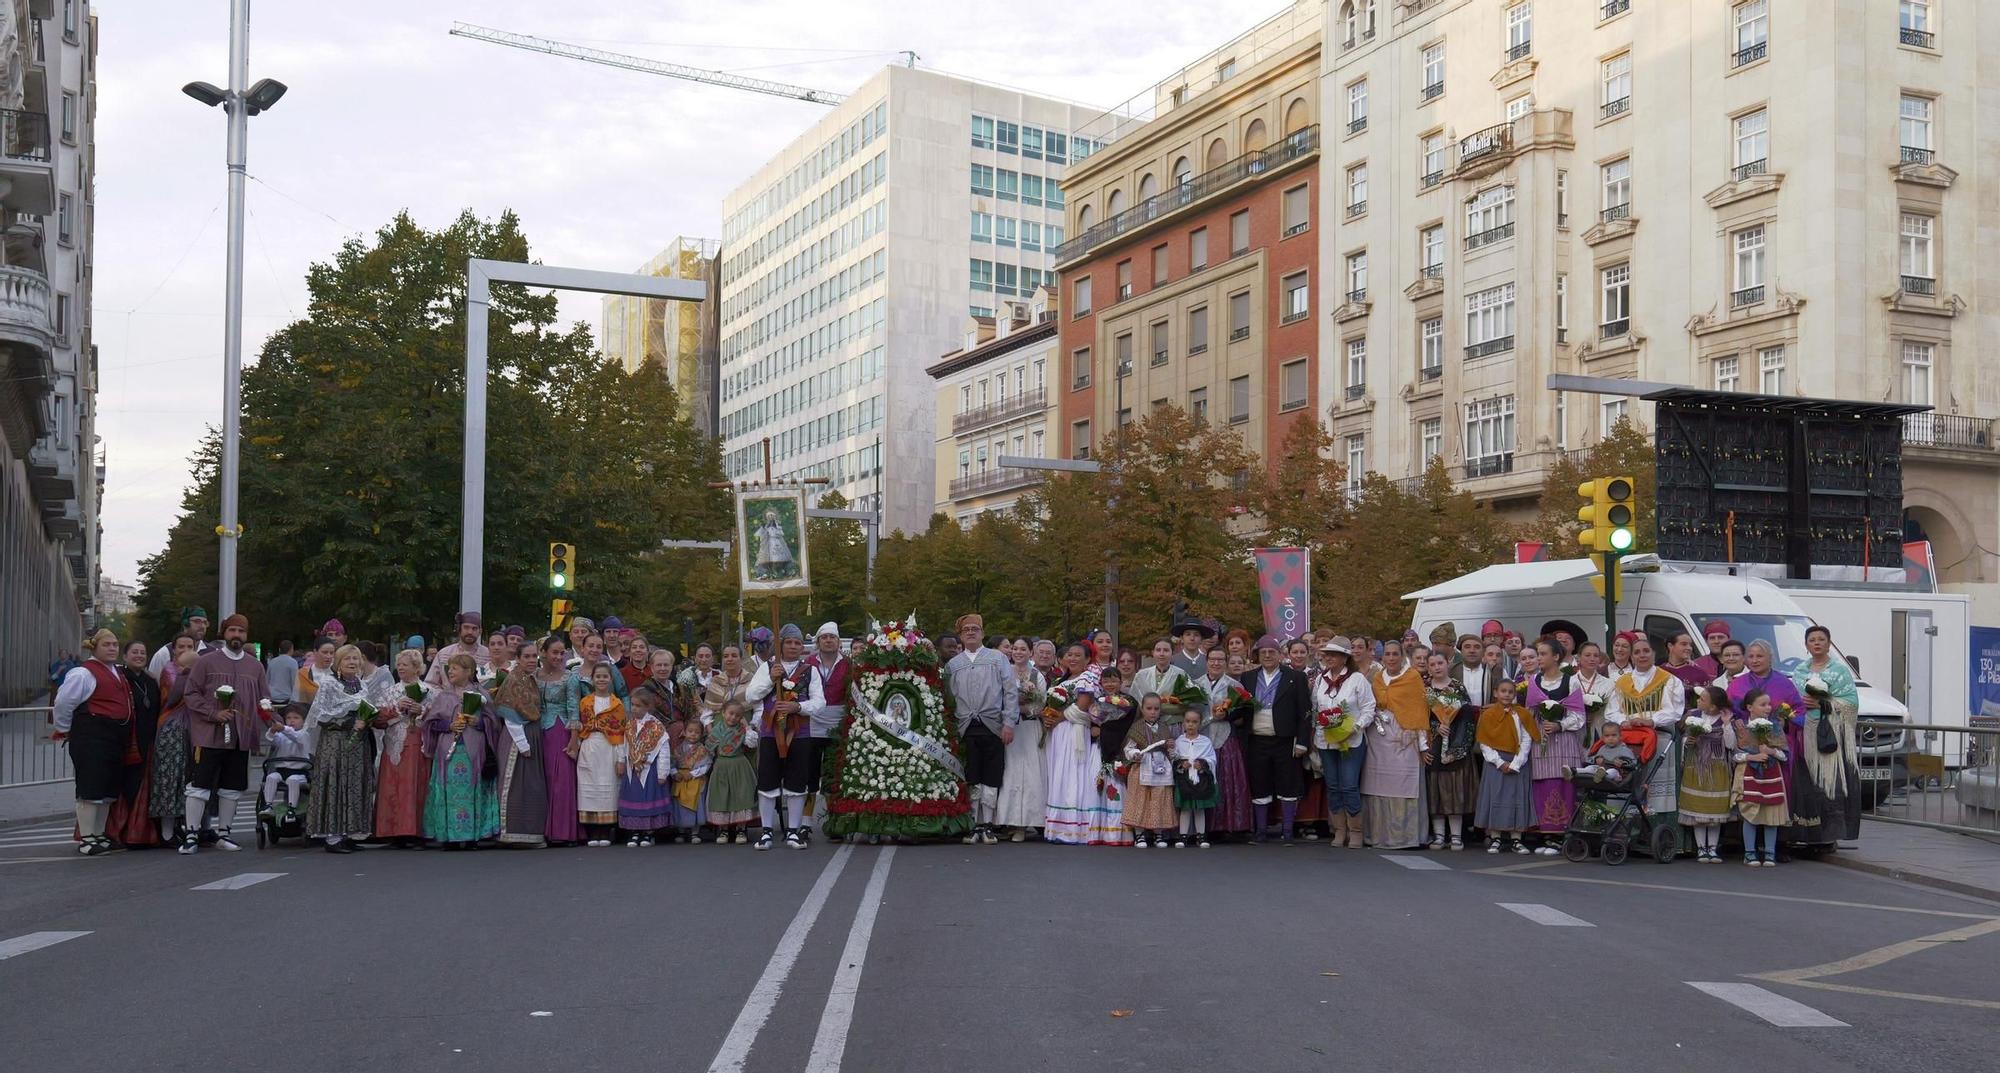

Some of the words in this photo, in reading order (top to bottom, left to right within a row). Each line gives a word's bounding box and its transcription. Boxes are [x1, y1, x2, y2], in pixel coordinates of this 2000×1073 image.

[1980, 658, 1993, 671] 130
[1978, 671, 1986, 684] de
[911, 735, 920, 745] LA
[924, 743, 938, 754] PAZ
